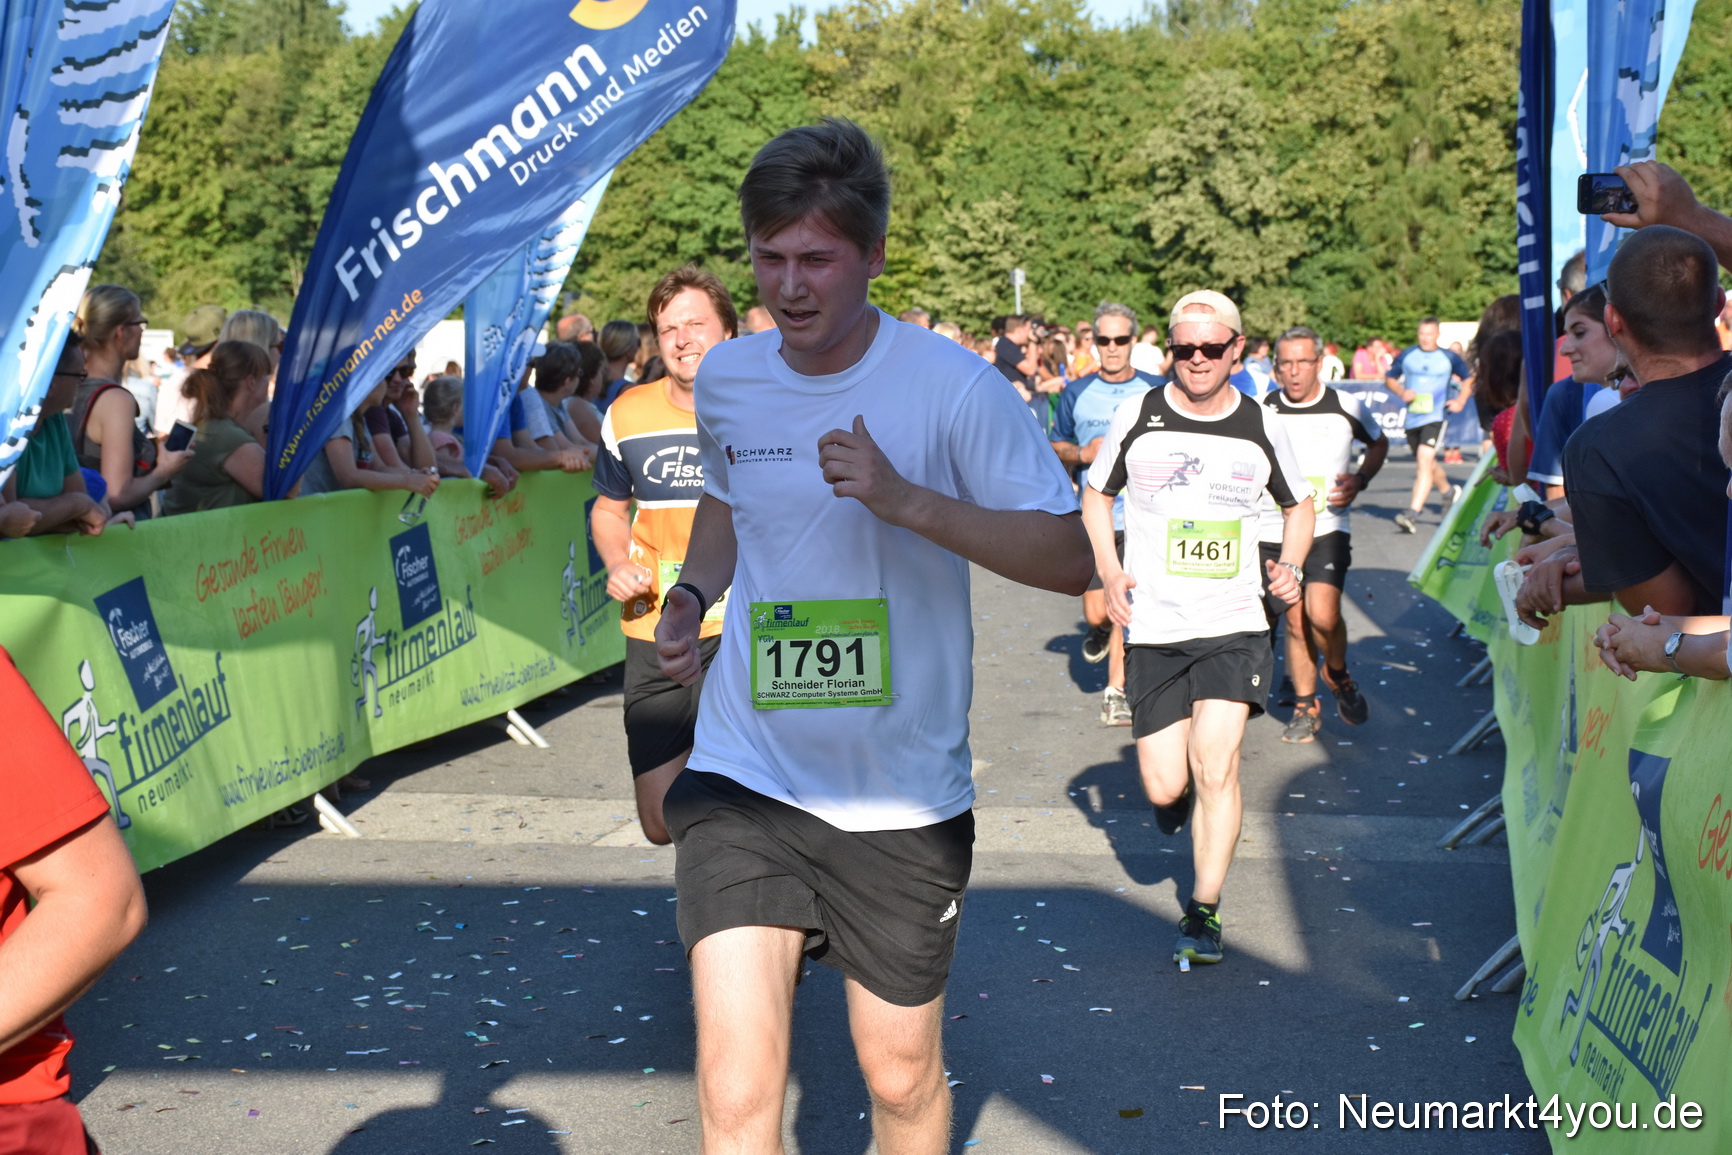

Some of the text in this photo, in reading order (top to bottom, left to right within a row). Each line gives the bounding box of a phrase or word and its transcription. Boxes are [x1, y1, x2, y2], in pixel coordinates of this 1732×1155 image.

[509, 5, 709, 187] Druck und Medien
[335, 44, 607, 302] Frischmann
[736, 448, 793, 458] SCHWARZ
[1209, 482, 1251, 495] VORSICHT!
[196, 528, 308, 602] Gesunde Firmen
[1177, 540, 1230, 560] 1461
[233, 555, 328, 639] laufen länger!
[385, 584, 477, 684] firmenlauf
[766, 617, 809, 627] firmenlauf
[815, 625, 840, 634] 2018
[767, 638, 864, 677] 1791
[389, 668, 435, 708] neumarkt
[757, 691, 790, 699] SCHWARZ
[793, 690, 827, 700] Computer
[828, 690, 858, 699] Systeme
[772, 679, 865, 690] Schneider Florian
[118, 651, 232, 784] firmenlauf
[138, 760, 194, 814] neumarkt
[1592, 921, 1713, 1098] firmenlauf
[1581, 1041, 1627, 1104] neumarkt
